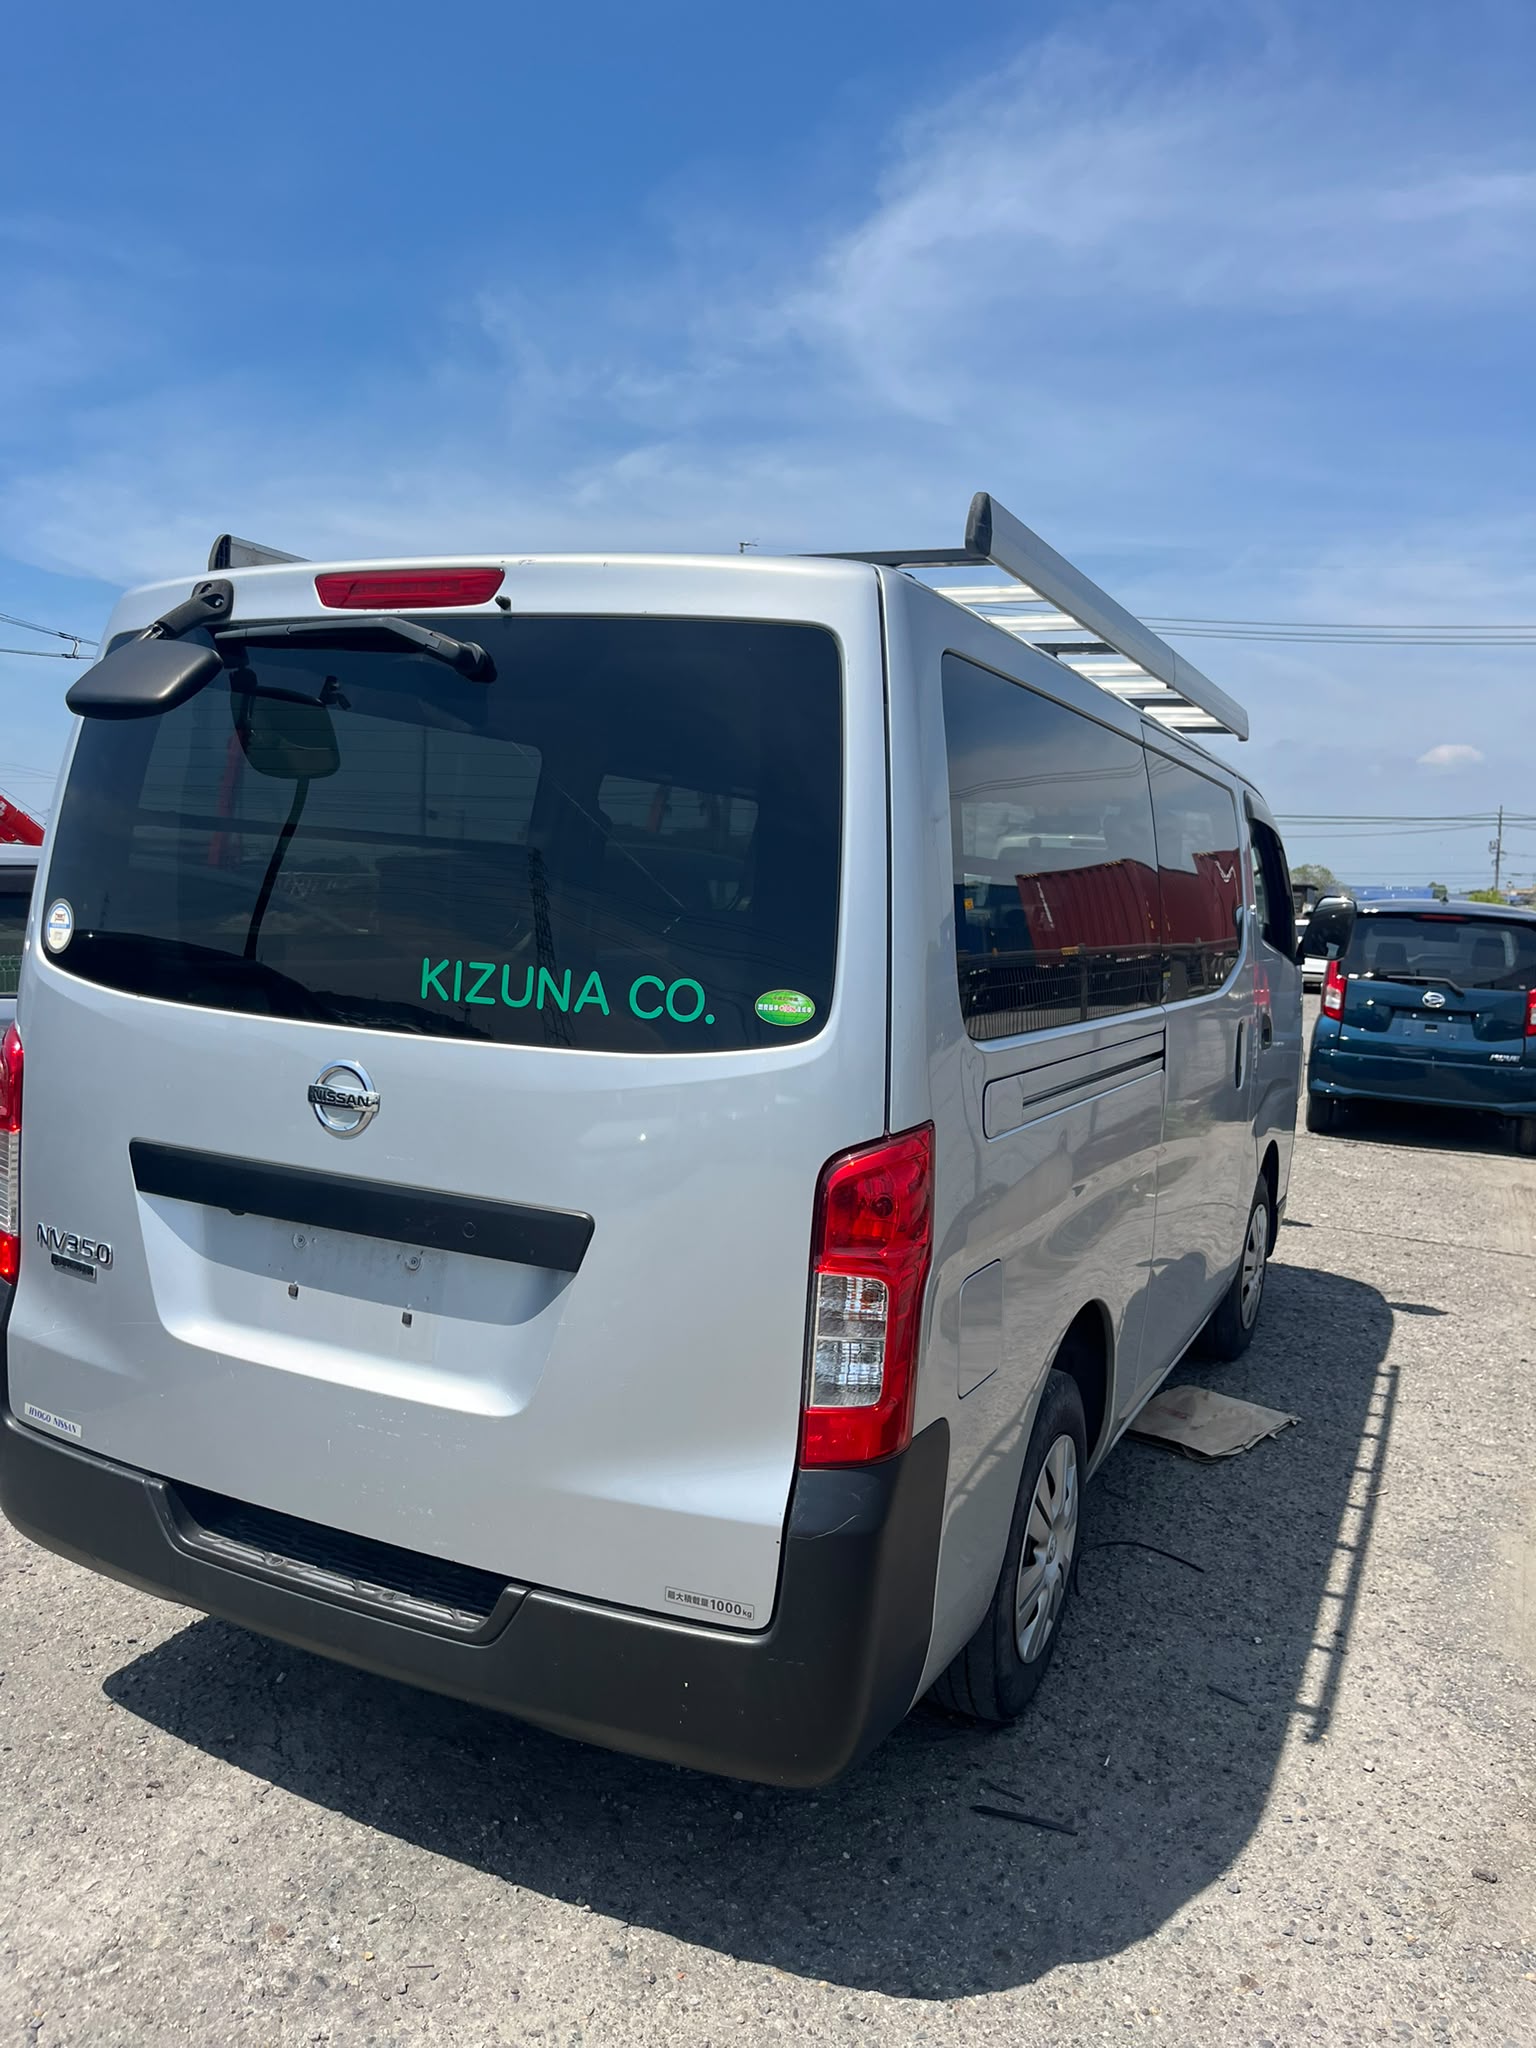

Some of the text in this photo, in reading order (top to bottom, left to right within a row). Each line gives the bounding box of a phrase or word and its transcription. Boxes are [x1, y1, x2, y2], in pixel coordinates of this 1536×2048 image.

[421, 957, 715, 1025] KIZUNA CO.
[311, 1087, 369, 1107] NISSAN
[37, 1222, 112, 1265] NV350
[53, 1417, 77, 1433] NISSAN
